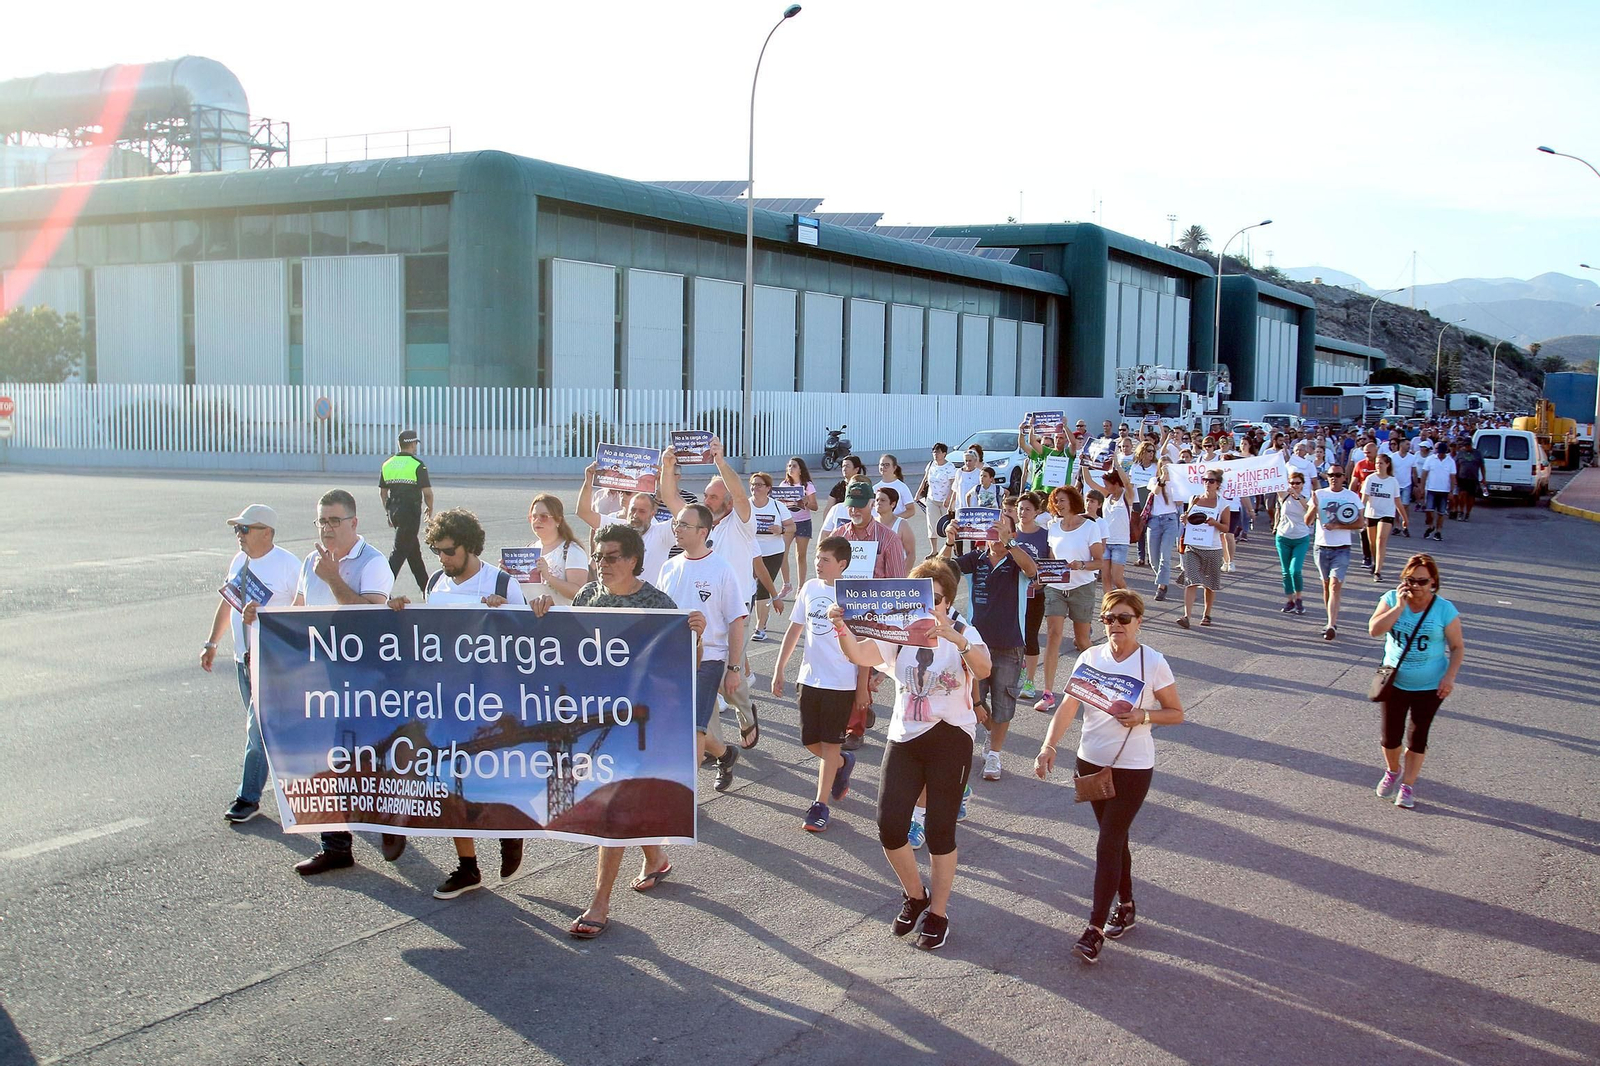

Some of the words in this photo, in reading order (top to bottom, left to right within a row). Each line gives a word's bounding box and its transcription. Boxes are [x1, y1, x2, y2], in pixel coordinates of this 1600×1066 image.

[0, 401, 13, 411] TOP
[1188, 465, 1205, 474] NO
[1223, 484, 1285, 500] CARBONERAS
[846, 590, 859, 598] No
[869, 590, 878, 598] la
[880, 590, 906, 599] carga
[908, 589, 920, 597] de
[846, 601, 879, 610] mineral
[882, 601, 893, 610] de
[896, 600, 922, 609] hierro
[865, 613, 918, 622] Carboneras
[308, 625, 364, 662] No
[379, 632, 402, 662] a
[413, 624, 443, 662] la
[454, 634, 564, 674] carga
[578, 628, 630, 667] de
[1108, 676, 1125, 685] carga
[1114, 683, 1132, 694] hierro
[305, 682, 443, 720] mineral
[454, 684, 504, 721] de
[520, 684, 633, 726] hierro
[326, 745, 378, 774] en
[390, 736, 614, 784] Carboneras
[278, 778, 358, 795] PLATAFORMA
[361, 778, 376, 794] DE
[378, 778, 449, 798] ASOCIACIONES
[288, 796, 348, 814] MUEVETE
[351, 795, 374, 812] POR
[376, 796, 442, 817] CARBONERAS
